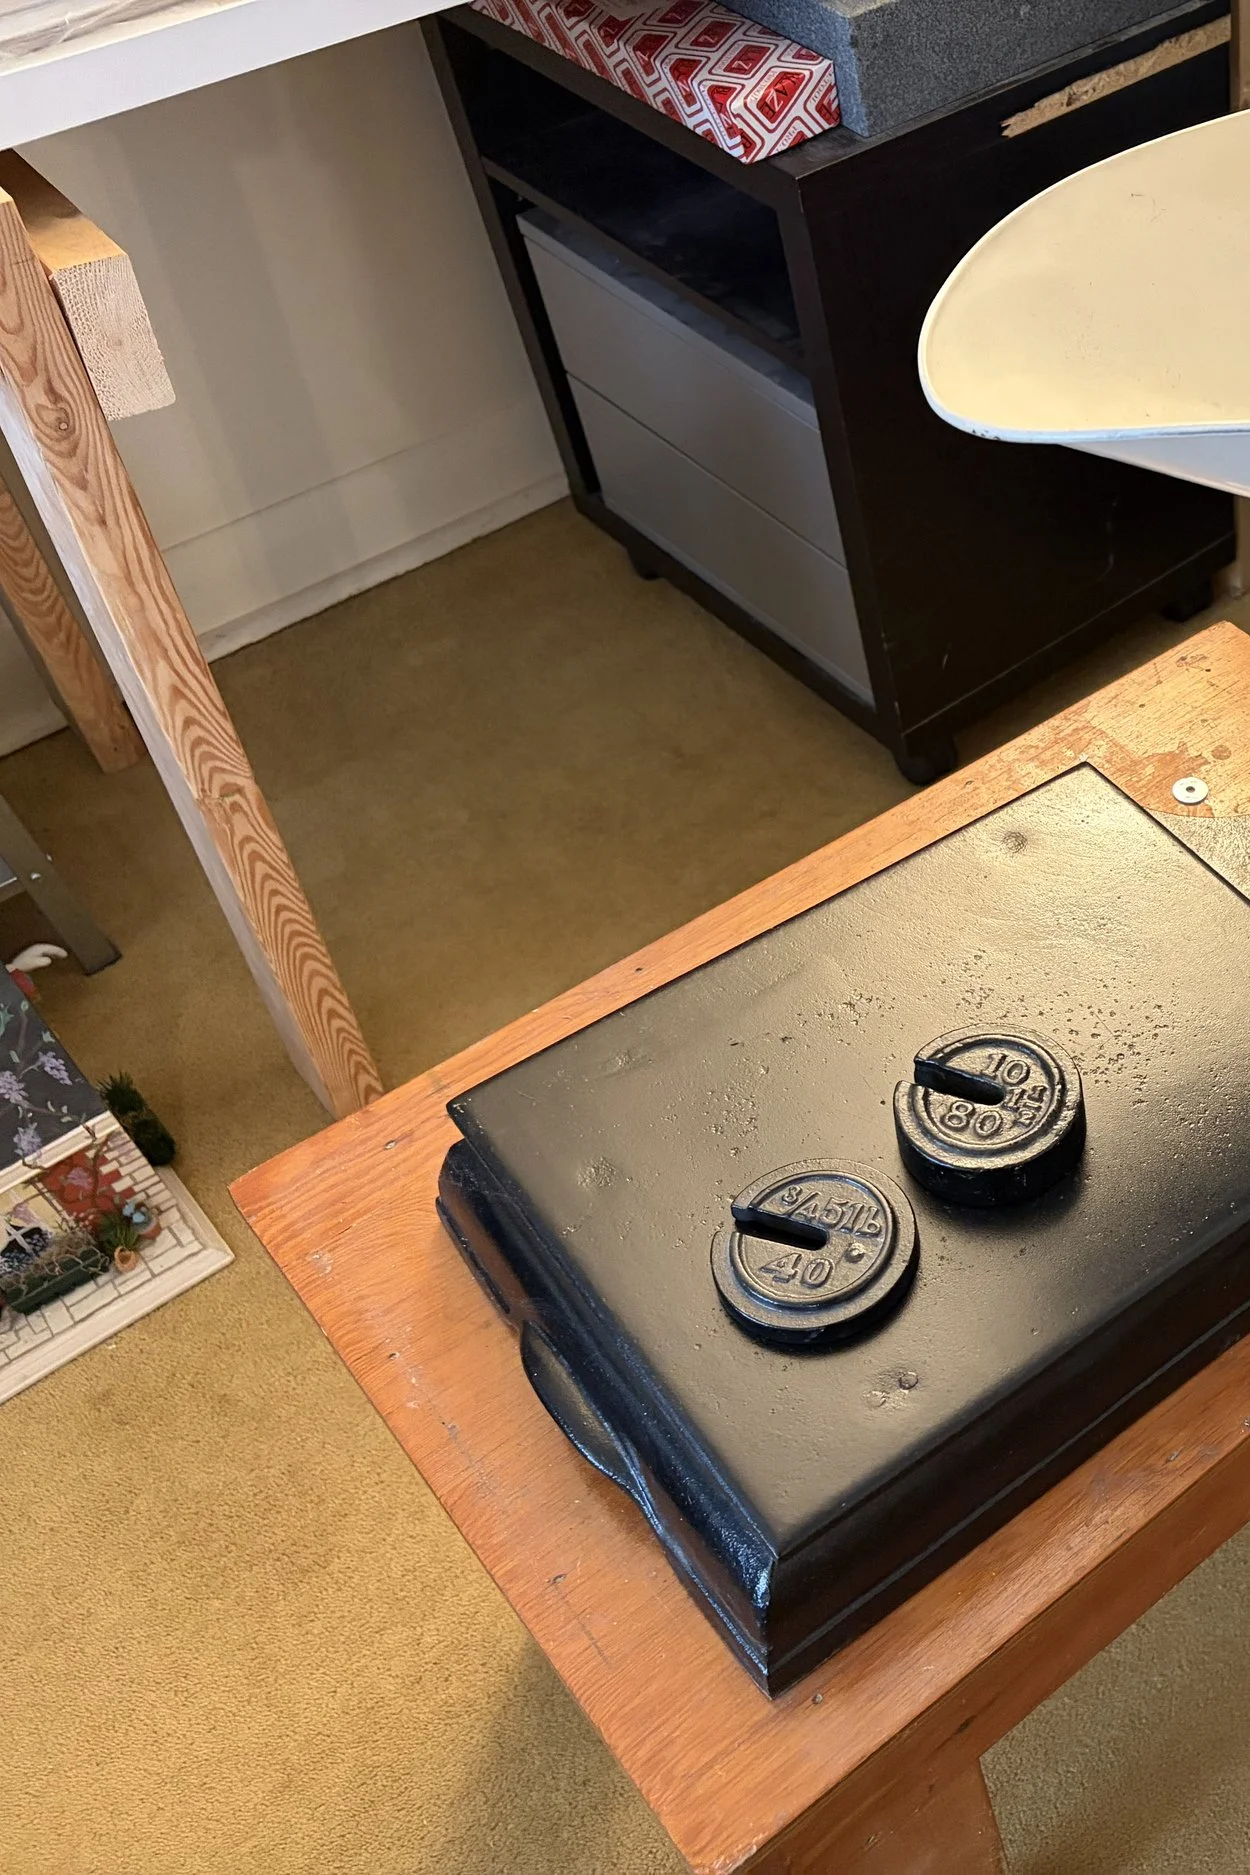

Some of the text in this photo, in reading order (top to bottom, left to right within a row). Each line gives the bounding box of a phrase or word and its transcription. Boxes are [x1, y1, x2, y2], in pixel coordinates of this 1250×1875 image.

[980, 1052, 1032, 1086] 10
[942, 1099, 1004, 1138] 80
[759, 1251, 836, 1290] 40
